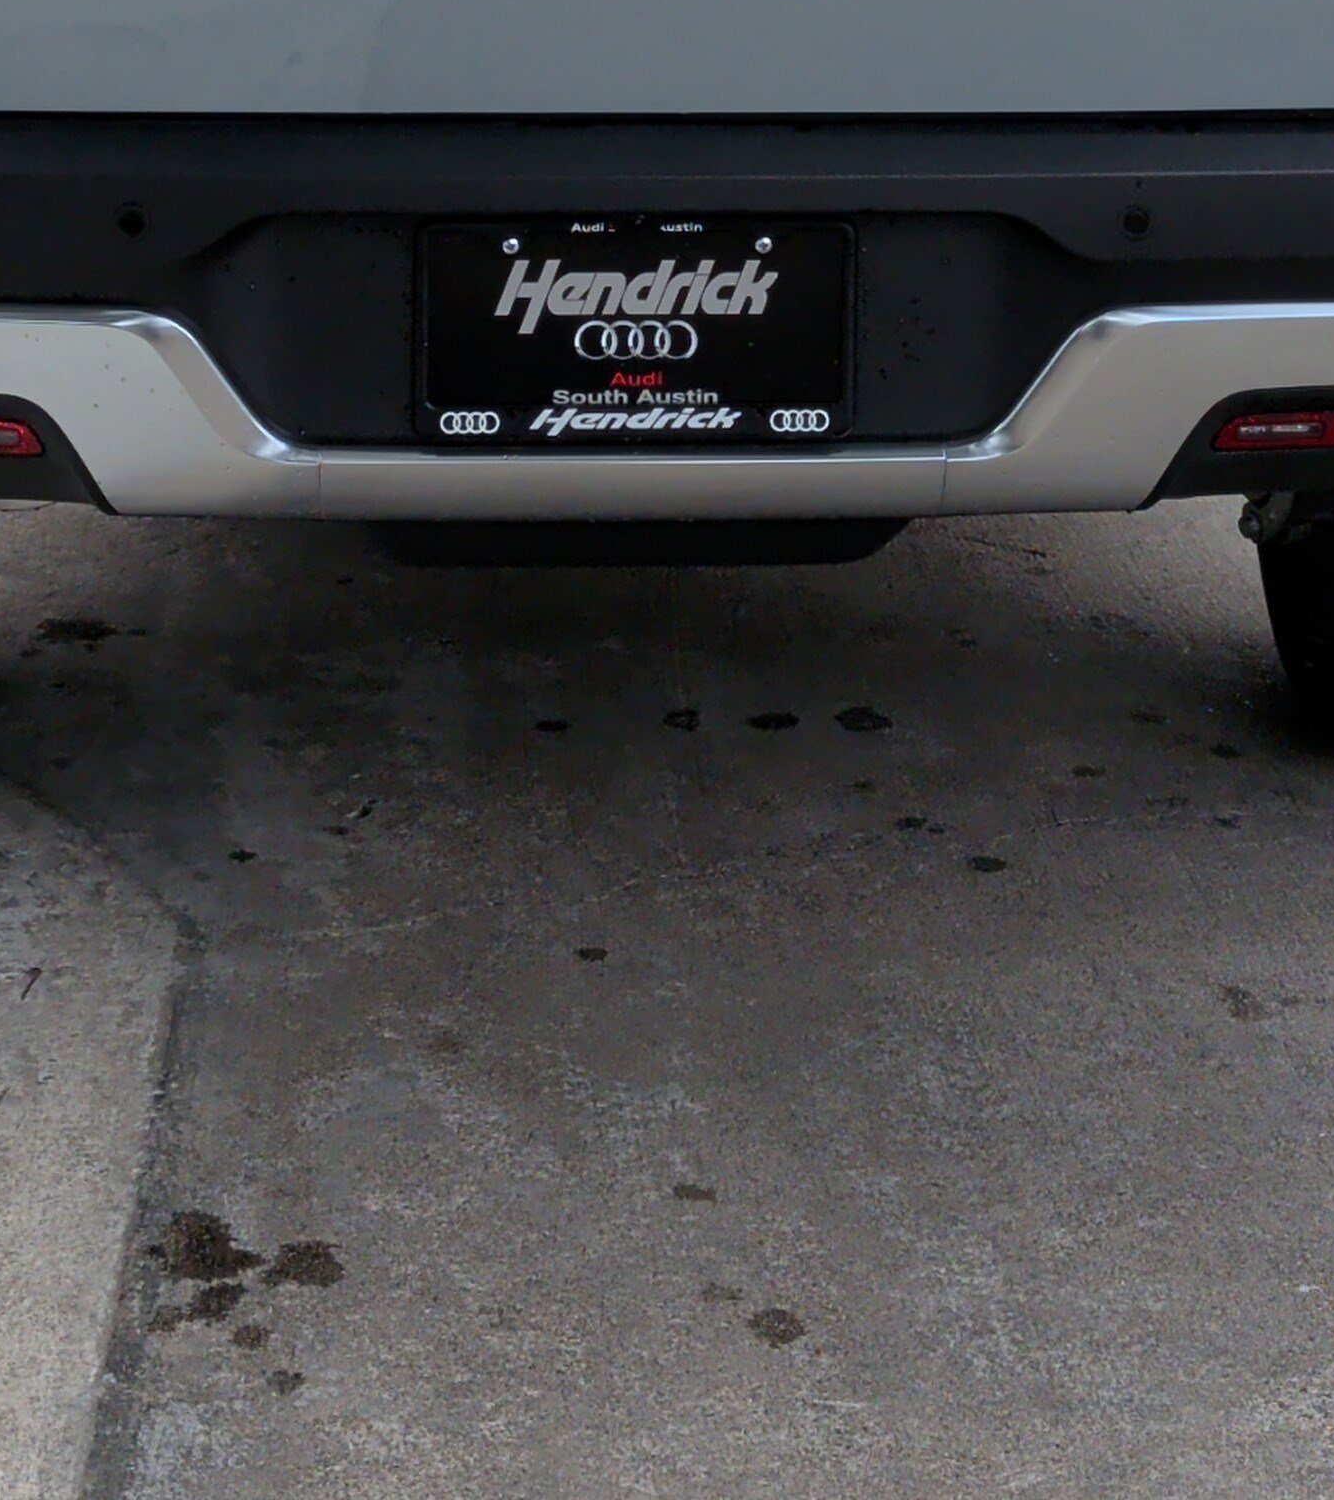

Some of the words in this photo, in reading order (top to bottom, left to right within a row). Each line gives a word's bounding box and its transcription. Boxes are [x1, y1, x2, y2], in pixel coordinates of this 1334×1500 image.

[571, 222, 605, 233] Audi
[494, 258, 779, 334] Hendrick
[610, 371, 663, 387] Audi
[552, 389, 629, 405] South
[636, 389, 719, 405] Austin
[529, 407, 743, 437] Hendrick
